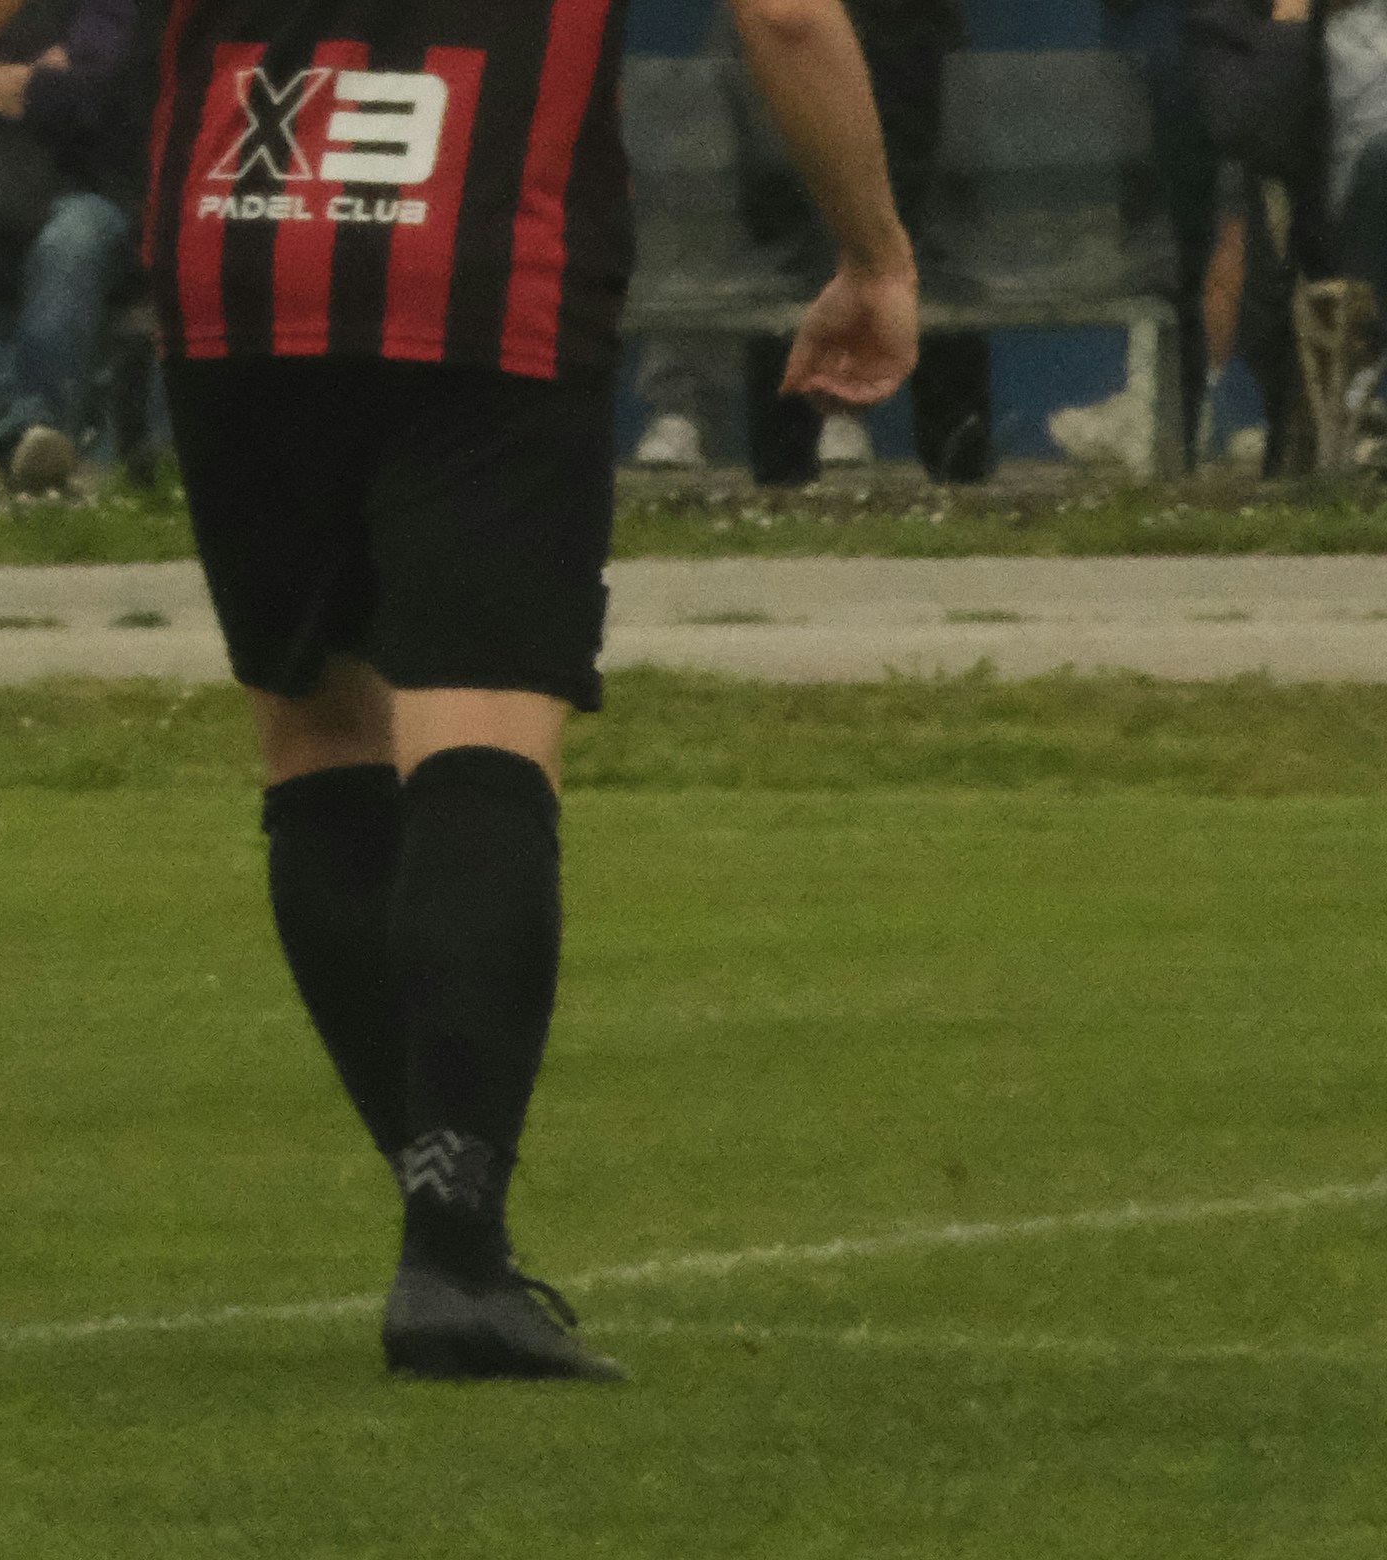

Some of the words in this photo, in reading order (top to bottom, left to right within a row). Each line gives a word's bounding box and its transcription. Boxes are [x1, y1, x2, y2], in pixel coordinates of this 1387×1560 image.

[208, 67, 450, 185] X3
[198, 194, 313, 223] PADEL
[326, 195, 431, 227] CLUB
